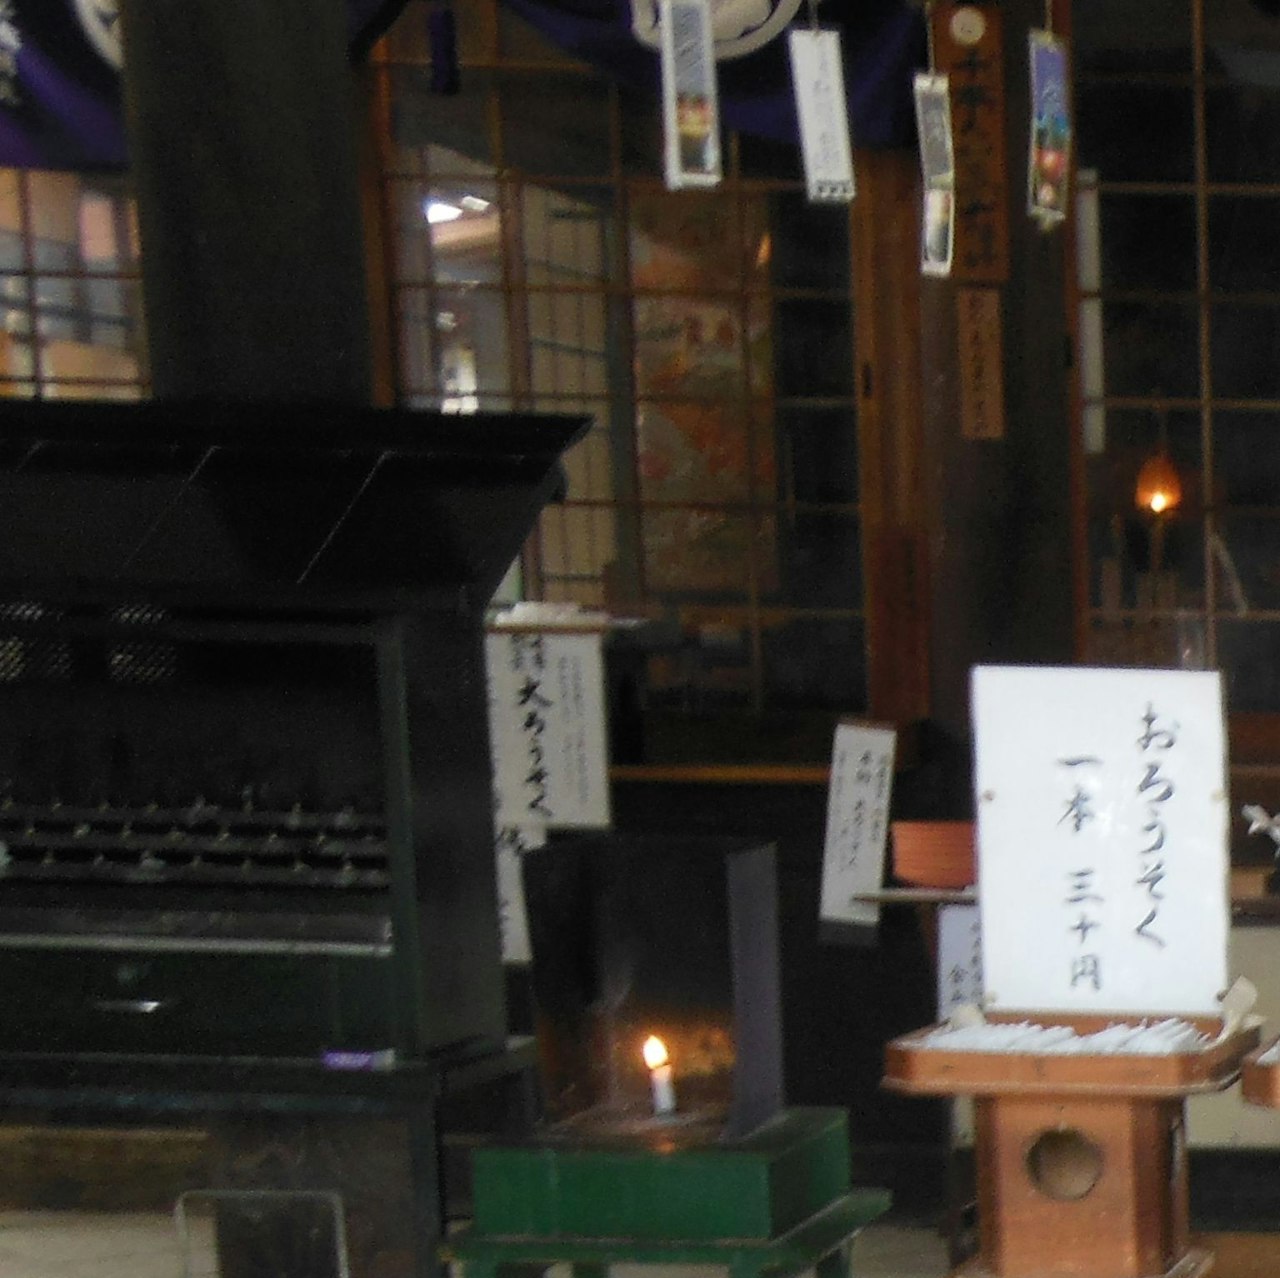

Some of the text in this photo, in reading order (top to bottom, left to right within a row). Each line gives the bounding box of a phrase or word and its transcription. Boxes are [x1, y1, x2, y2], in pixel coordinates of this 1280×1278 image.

[1132, 699, 1181, 950] おろうそく
